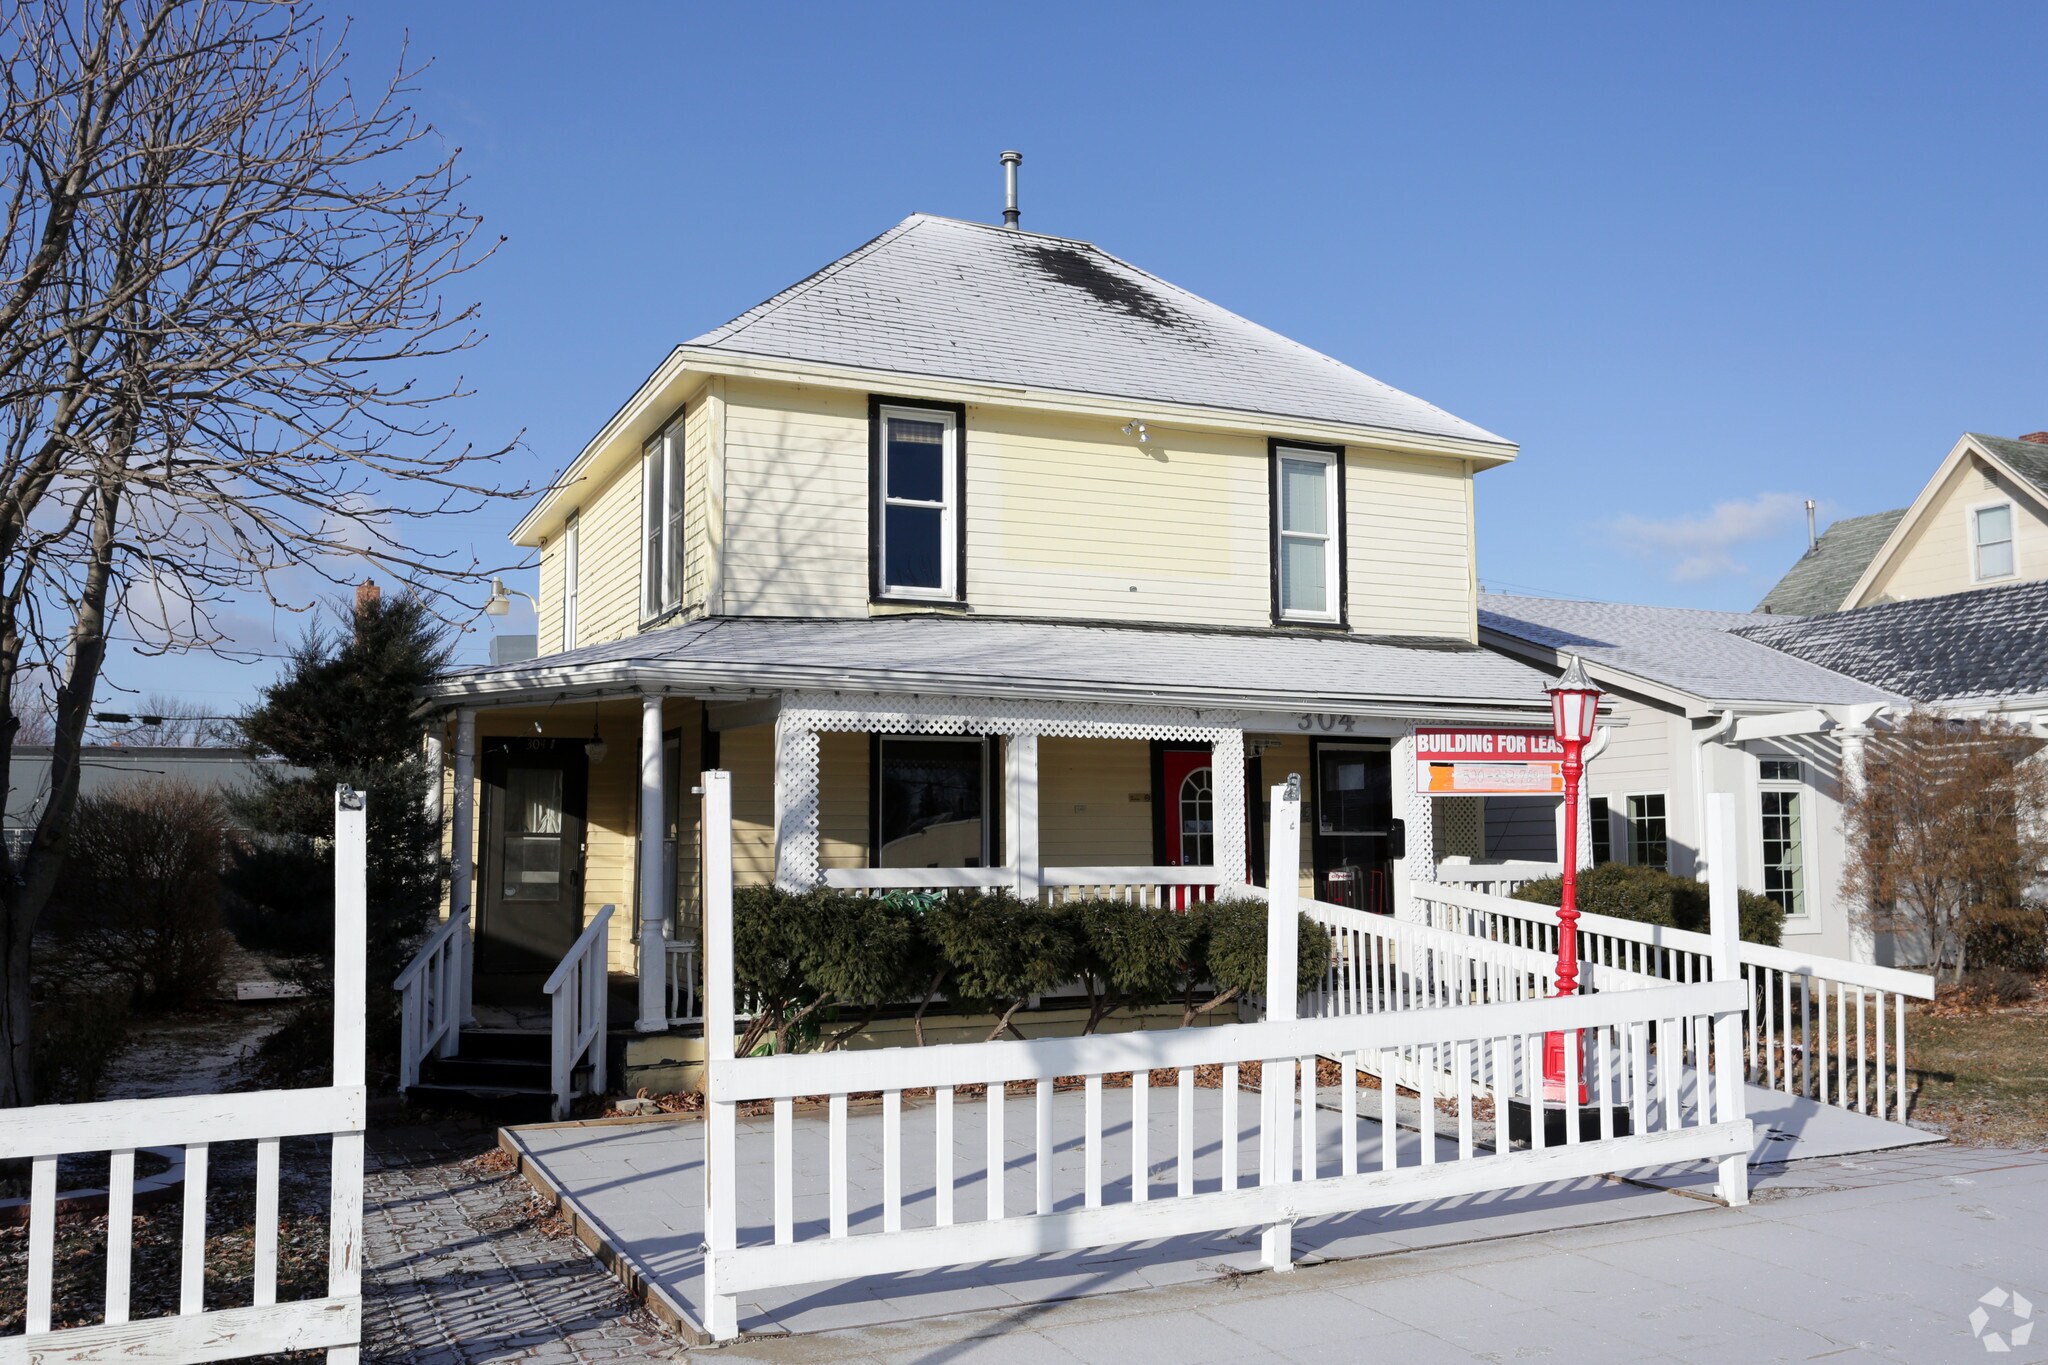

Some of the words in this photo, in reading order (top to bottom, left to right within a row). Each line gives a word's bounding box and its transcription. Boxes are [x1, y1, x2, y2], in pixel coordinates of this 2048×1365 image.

[1297, 712, 1356, 732] 304
[1417, 733, 1493, 753] BUILDING
[1497, 735, 1526, 753] FOR
[1530, 736, 1564, 753] LEAS
